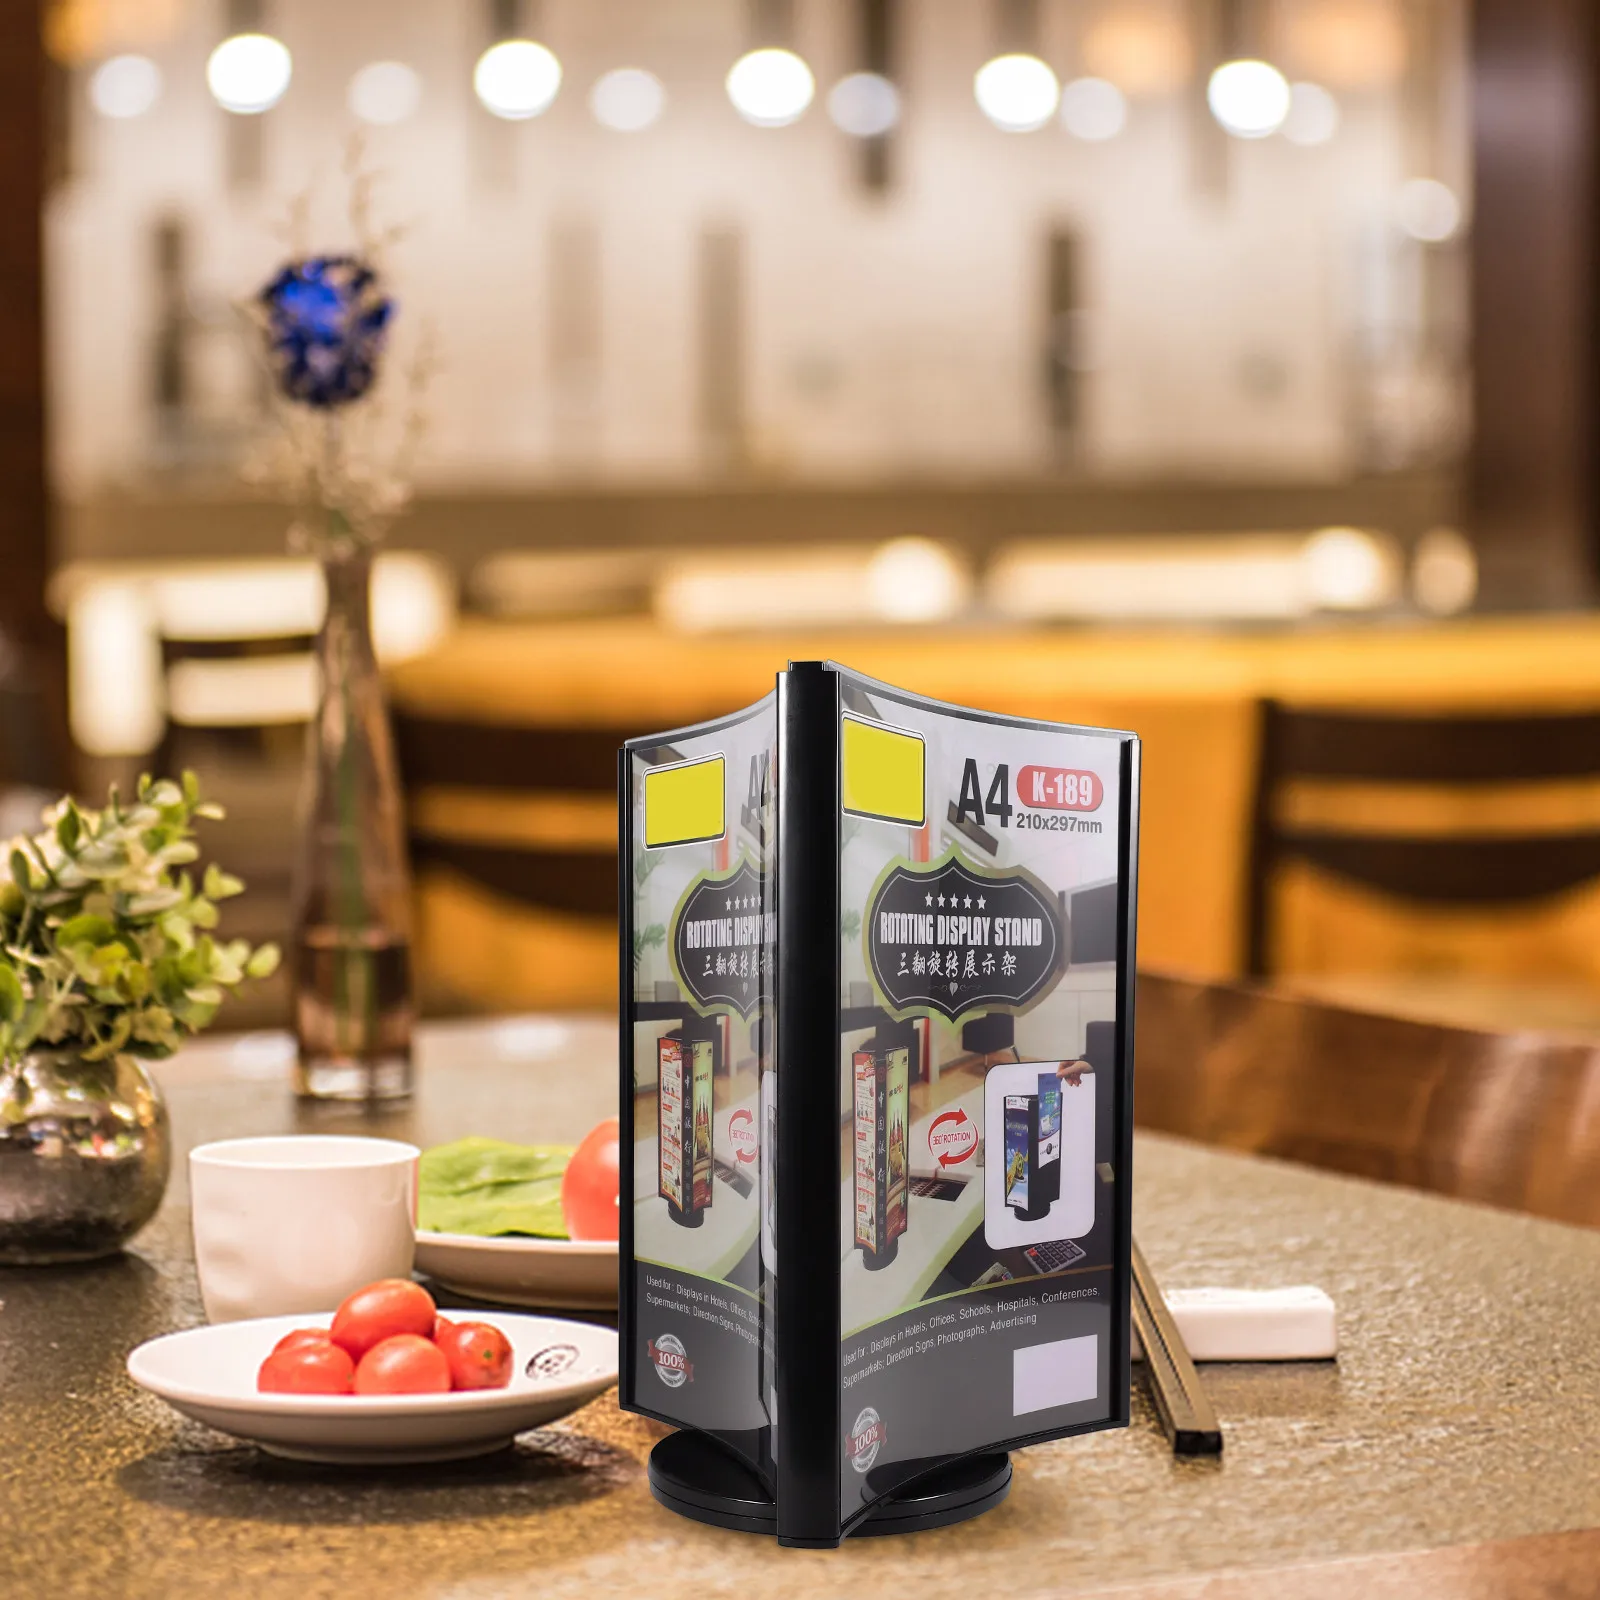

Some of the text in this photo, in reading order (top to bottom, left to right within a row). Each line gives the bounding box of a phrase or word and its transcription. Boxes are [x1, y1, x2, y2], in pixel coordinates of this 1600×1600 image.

[956, 758, 1012, 828] A4
[1032, 771, 1093, 806] K-189
[1016, 812, 1102, 833] 210x297mm
[686, 918, 732, 949] ROTATING
[880, 911, 1043, 946] ROTATING DISPLAY STAND
[646, 1275, 662, 1288] Used
[676, 1284, 703, 1302] Displays
[703, 1292, 710, 1303] in
[692, 1305, 719, 1324] Direction
[843, 1352, 857, 1367] Used
[870, 1334, 896, 1354] Displays
[897, 1329, 904, 1341] in
[905, 1321, 928, 1338] Hotels,
[929, 1312, 957, 1328] Offices,
[959, 1303, 993, 1320] Schools,
[997, 1296, 1039, 1312] Hospitals,
[886, 1346, 914, 1366] Direction
[989, 1314, 1037, 1332] Advertising
[658, 1351, 685, 1369] 100%
[854, 1423, 878, 1454] 100%
